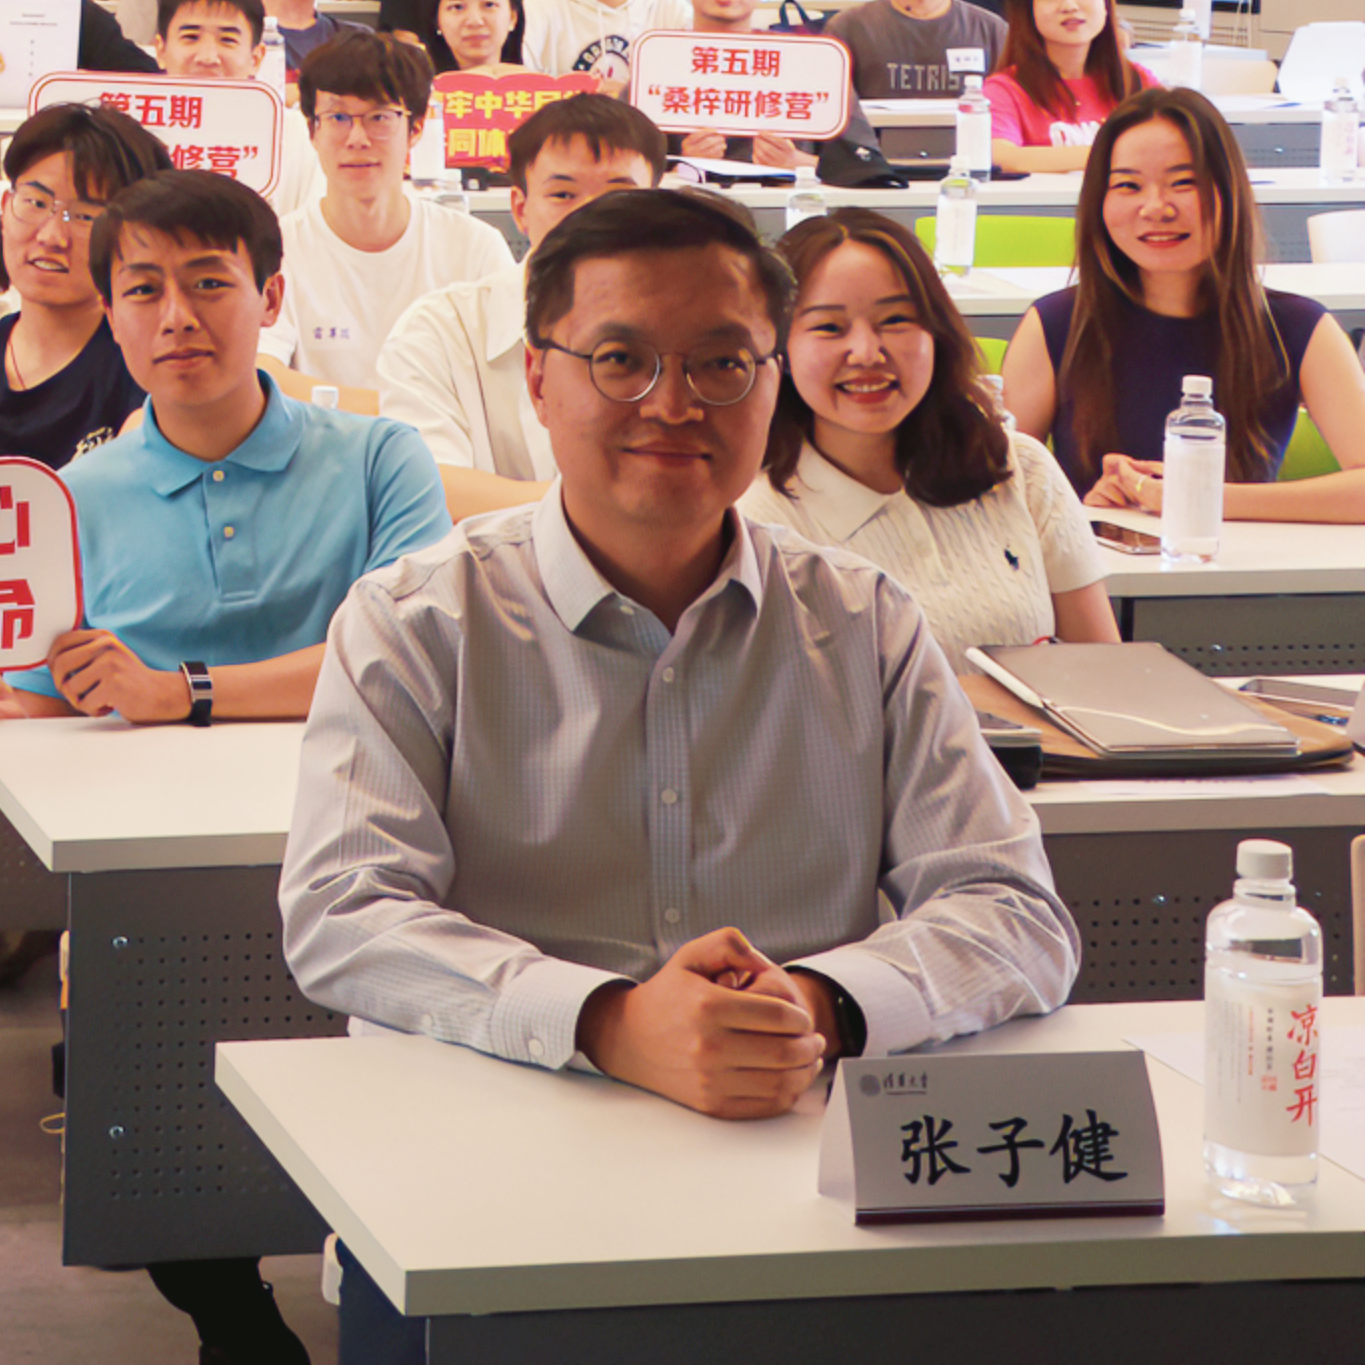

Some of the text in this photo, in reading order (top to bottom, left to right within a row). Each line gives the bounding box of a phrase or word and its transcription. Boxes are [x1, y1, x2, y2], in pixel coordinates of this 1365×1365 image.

[691, 46, 780, 77] 第五期
[887, 62, 960, 91] TETRIS
[648, 84, 829, 120] “桑梓研修营”
[1286, 1004, 1318, 1126] 凉白开
[900, 1109, 1128, 1188] 张子健
